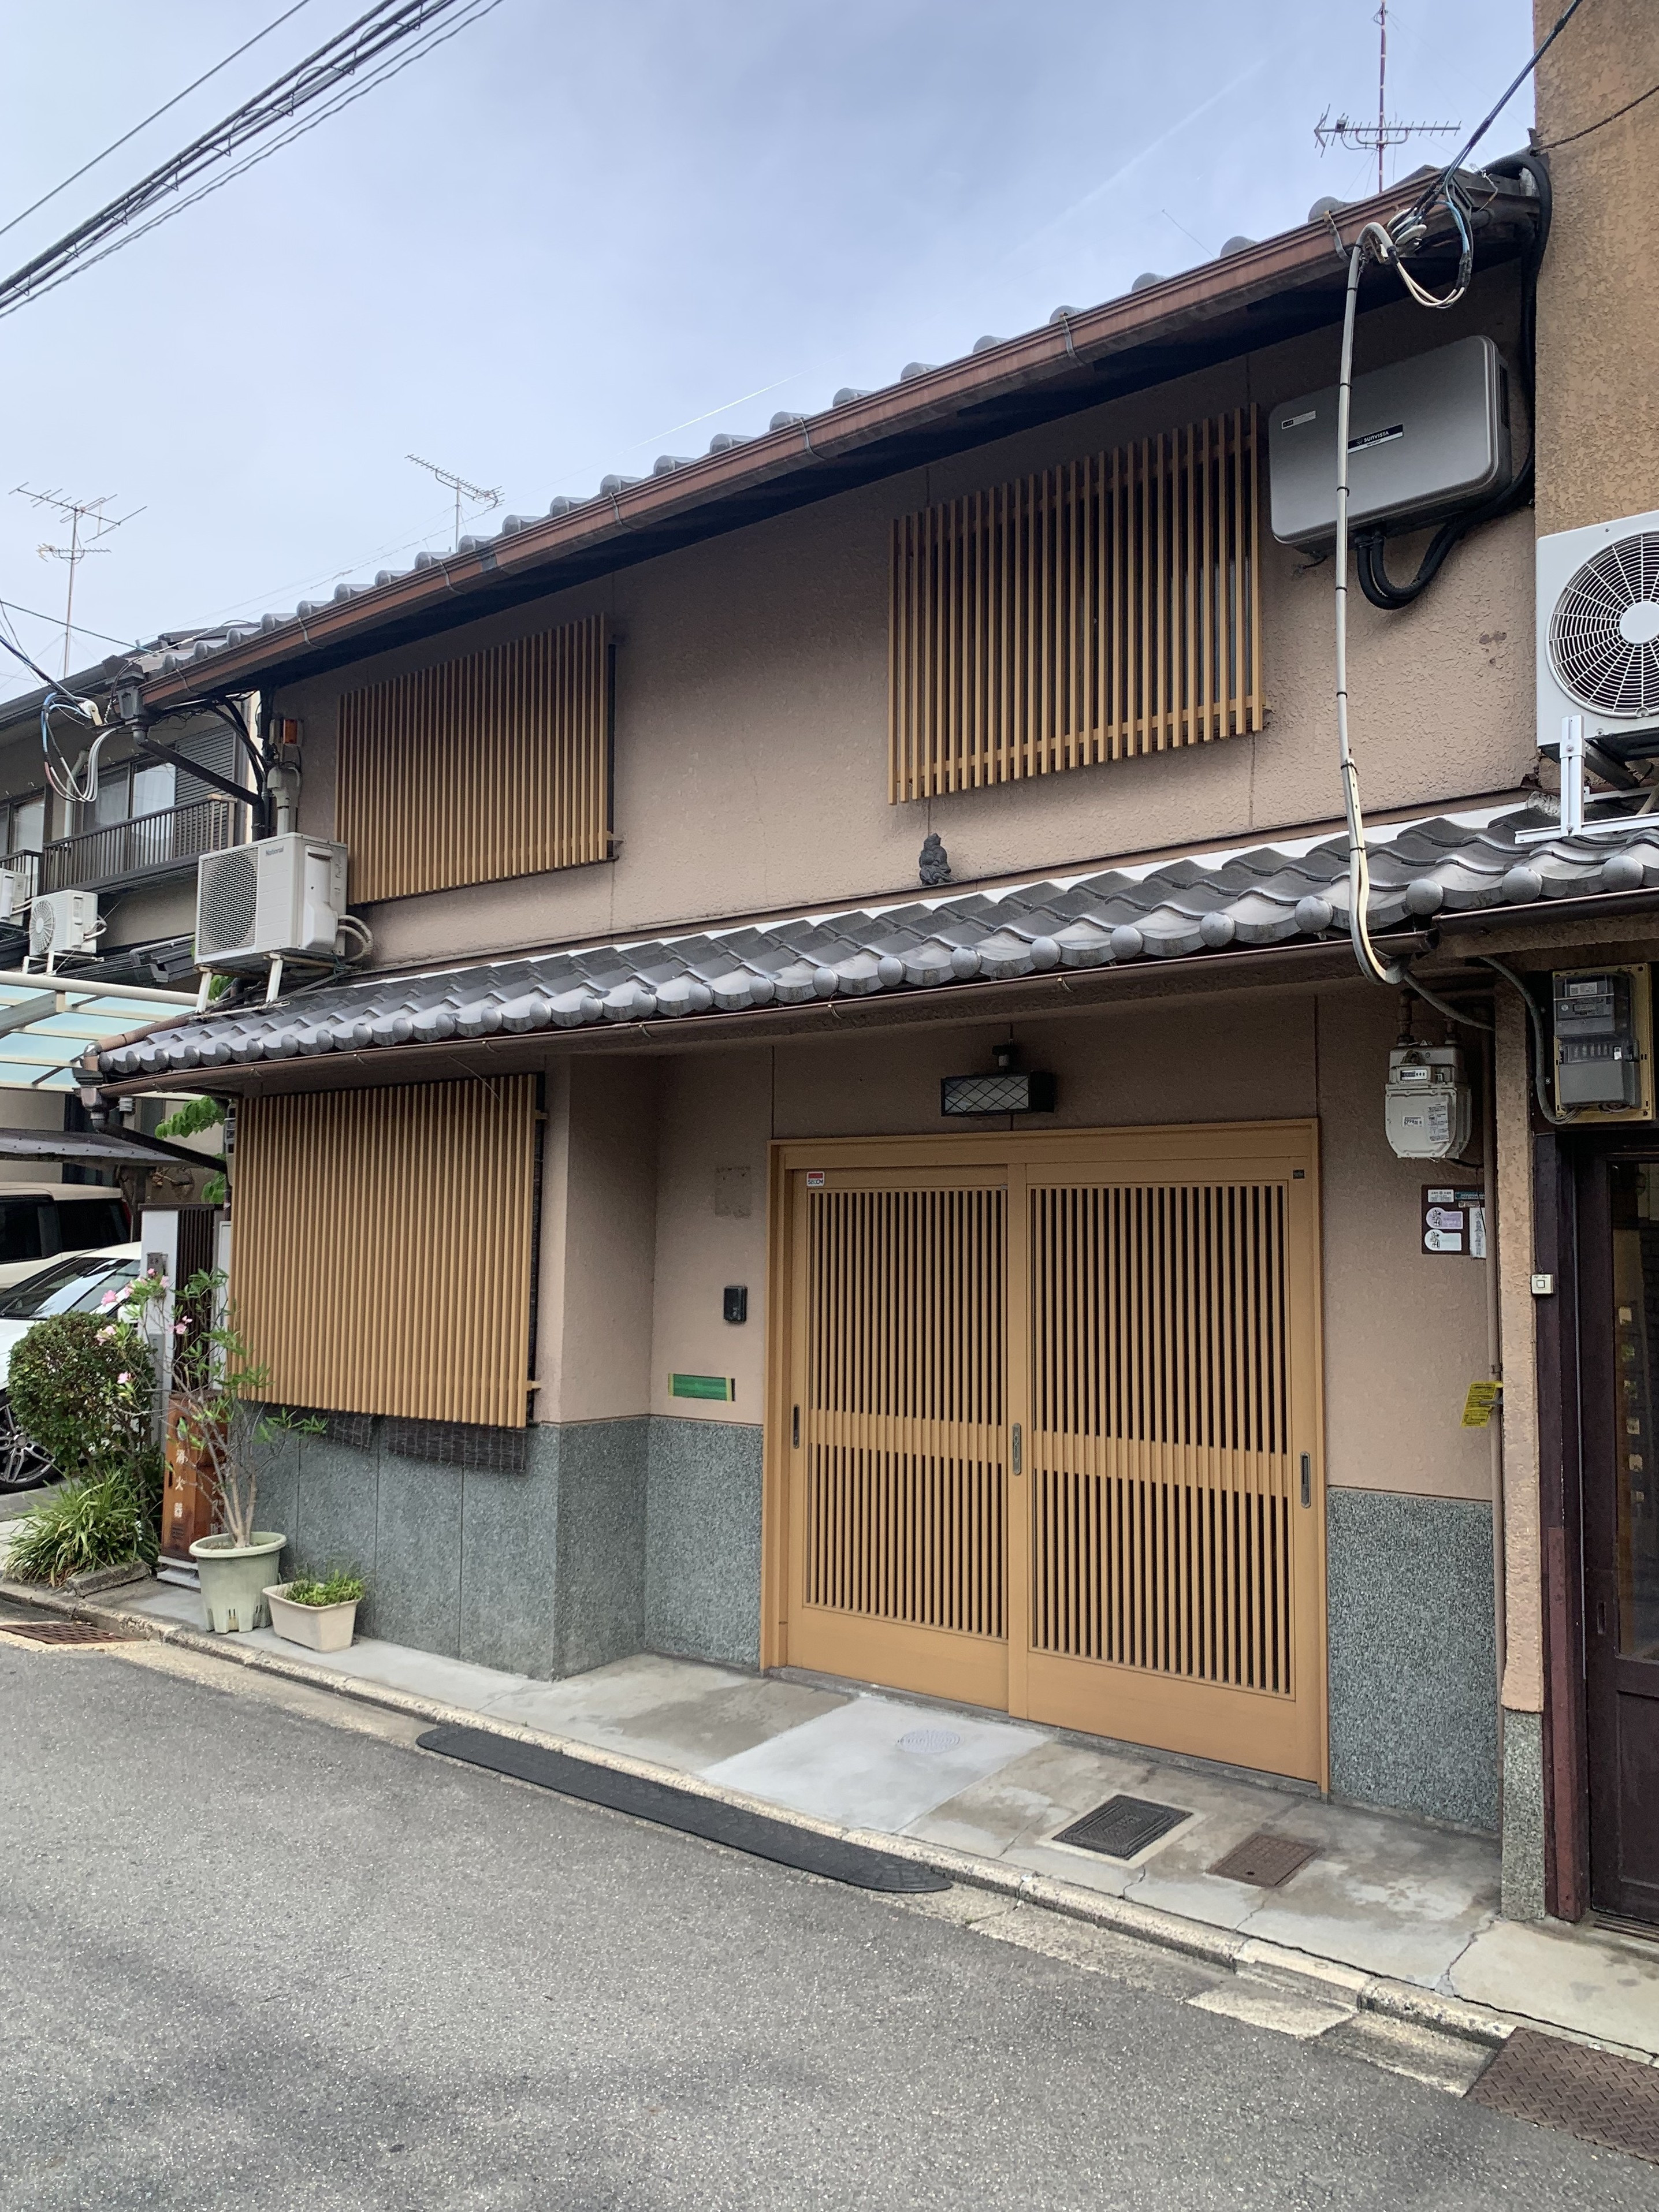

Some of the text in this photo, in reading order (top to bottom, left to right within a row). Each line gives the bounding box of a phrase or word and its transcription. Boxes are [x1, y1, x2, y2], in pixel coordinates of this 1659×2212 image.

[1364, 431, 1389, 443] SUNVISTA
[266, 846, 284, 856] National
[173, 1448, 187, 1518] 消火器
